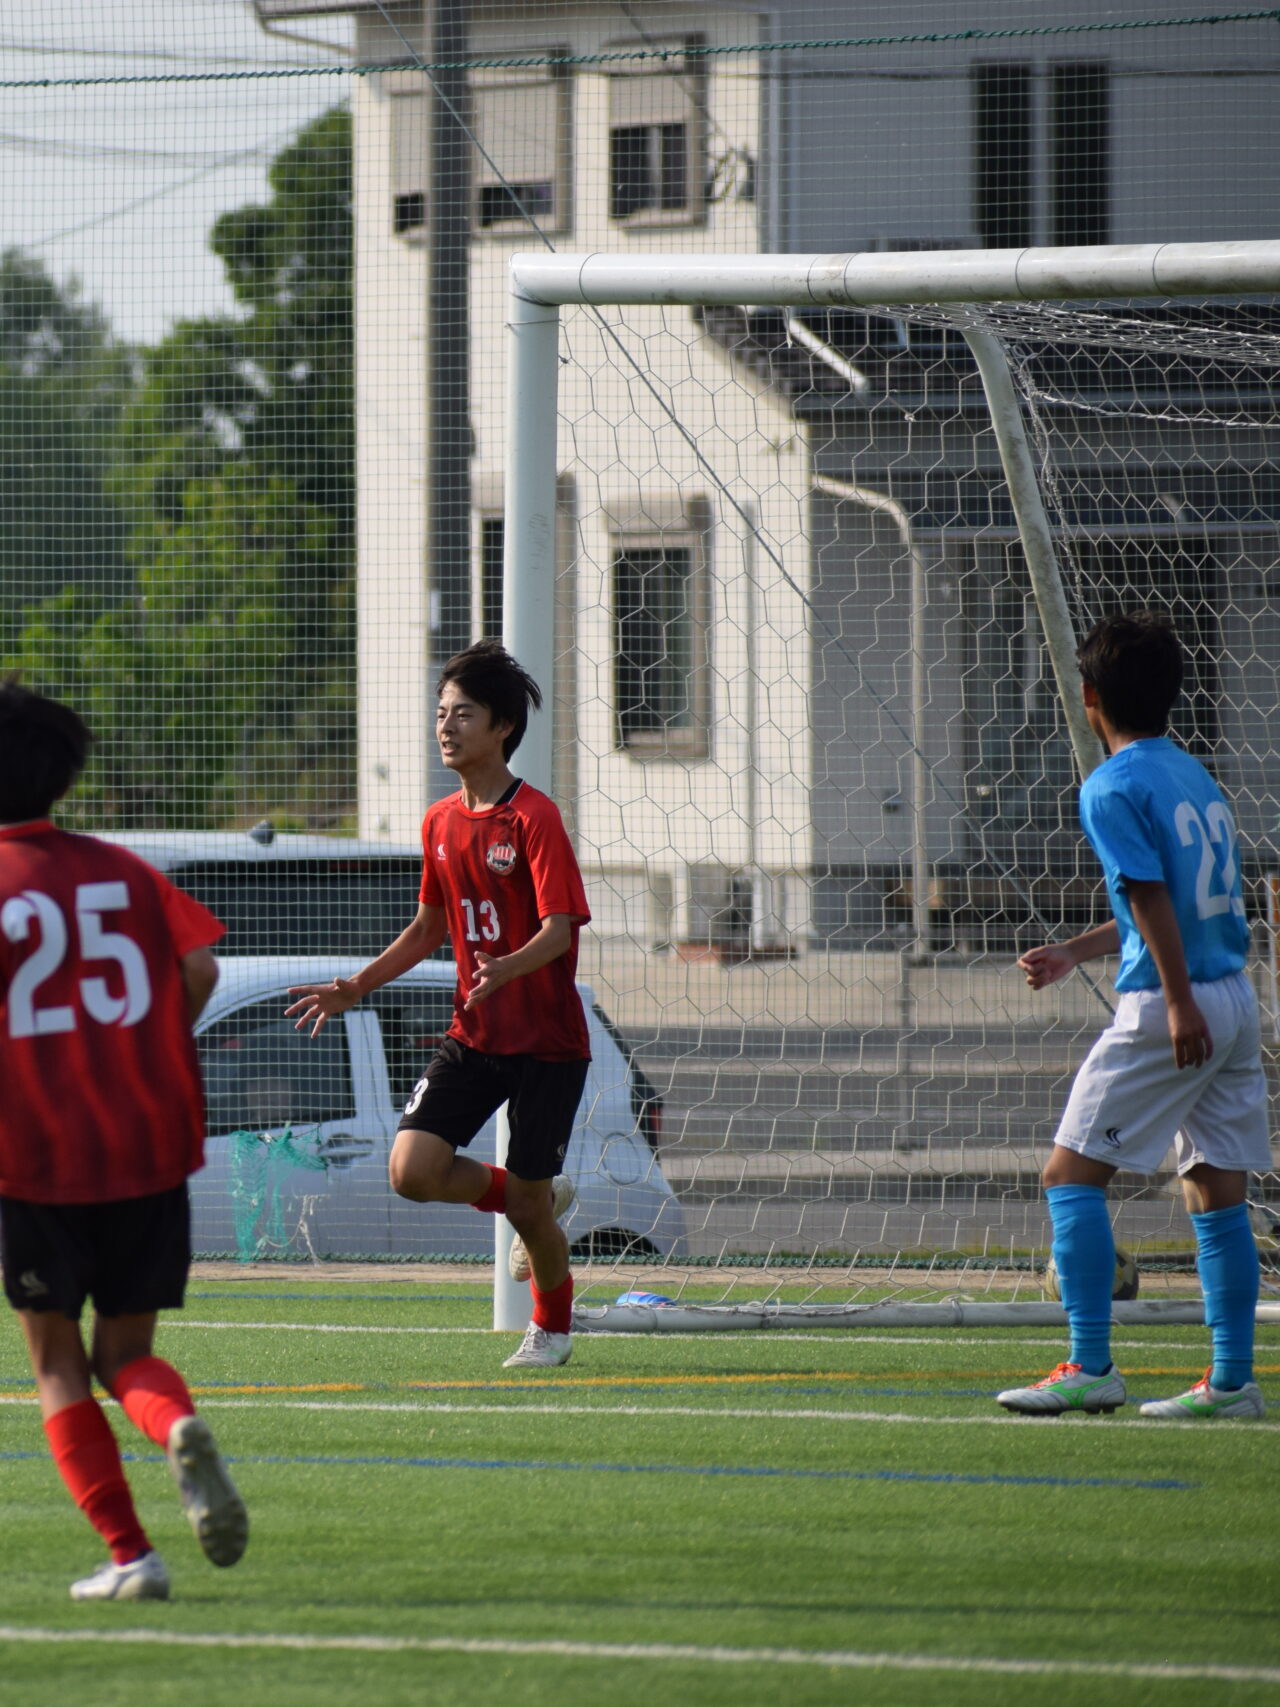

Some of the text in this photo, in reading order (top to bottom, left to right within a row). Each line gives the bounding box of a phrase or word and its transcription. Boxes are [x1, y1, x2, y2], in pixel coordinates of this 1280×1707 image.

[461, 898, 501, 942] 13
[1174, 801, 1247, 920] 22
[1, 882, 152, 1038] 25
